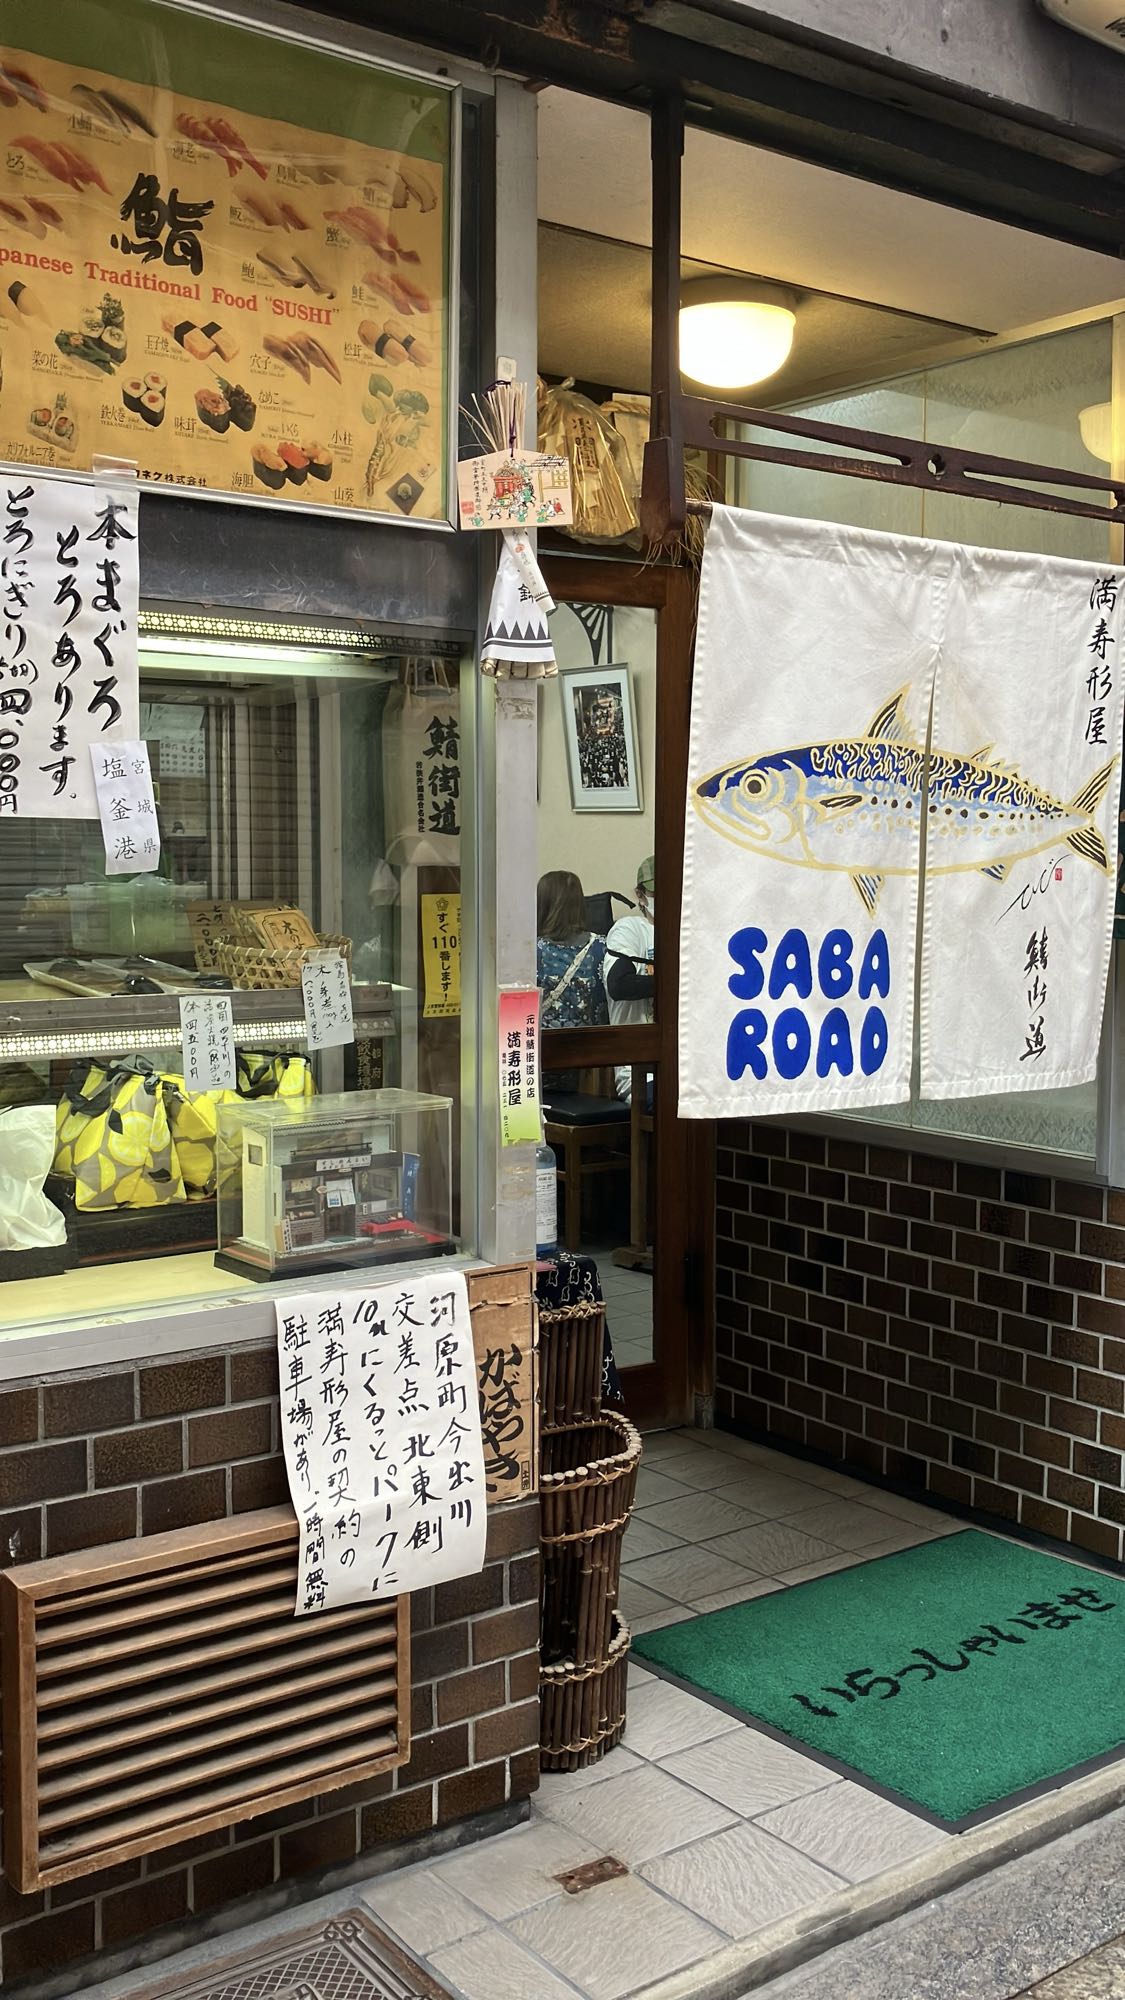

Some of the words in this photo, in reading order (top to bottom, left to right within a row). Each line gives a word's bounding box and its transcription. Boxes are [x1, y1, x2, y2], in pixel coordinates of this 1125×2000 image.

[6, 152, 25, 170] とろ
[110, 172, 215, 276] 鮨
[84, 261, 200, 301] Traditional
[211, 287, 258, 312] Food
[32, 350, 58, 370] 菜の花
[250, 353, 271, 370] 穴子
[258, 390, 280, 405] なめこ
[7, 441, 57, 462] カリフォルニア巻
[100, 404, 126, 423] 鉄火巻
[281, 423, 299, 437] いくら
[331, 429, 353, 446] 小柱
[232, 471, 254, 488] 海胆
[334, 486, 354, 503] 山葵
[86, 494, 137, 732] 本まぐろ
[39, 525, 82, 799] とろあります。
[1084, 574, 1119, 745] 満寿形屋
[102, 757, 138, 860] 塩釜港
[131, 759, 157, 854] 宮城県
[422, 715, 461, 836] 鯖街道
[728, 926, 890, 1000] SABA
[1018, 925, 1049, 1063] 鯖街道
[507, 1031, 521, 1106] 満寿形屋
[526, 1014, 536, 1099] 元祖鯖街道の店
[726, 1005, 889, 1081] ROAD
[317, 1302, 362, 1568] 満寿形屋の契約の
[392, 1292, 444, 1554] 交差点北東側
[430, 1291, 475, 1528] 河原町今出川
[789, 1586, 1117, 1718] いらっしゃいませ
